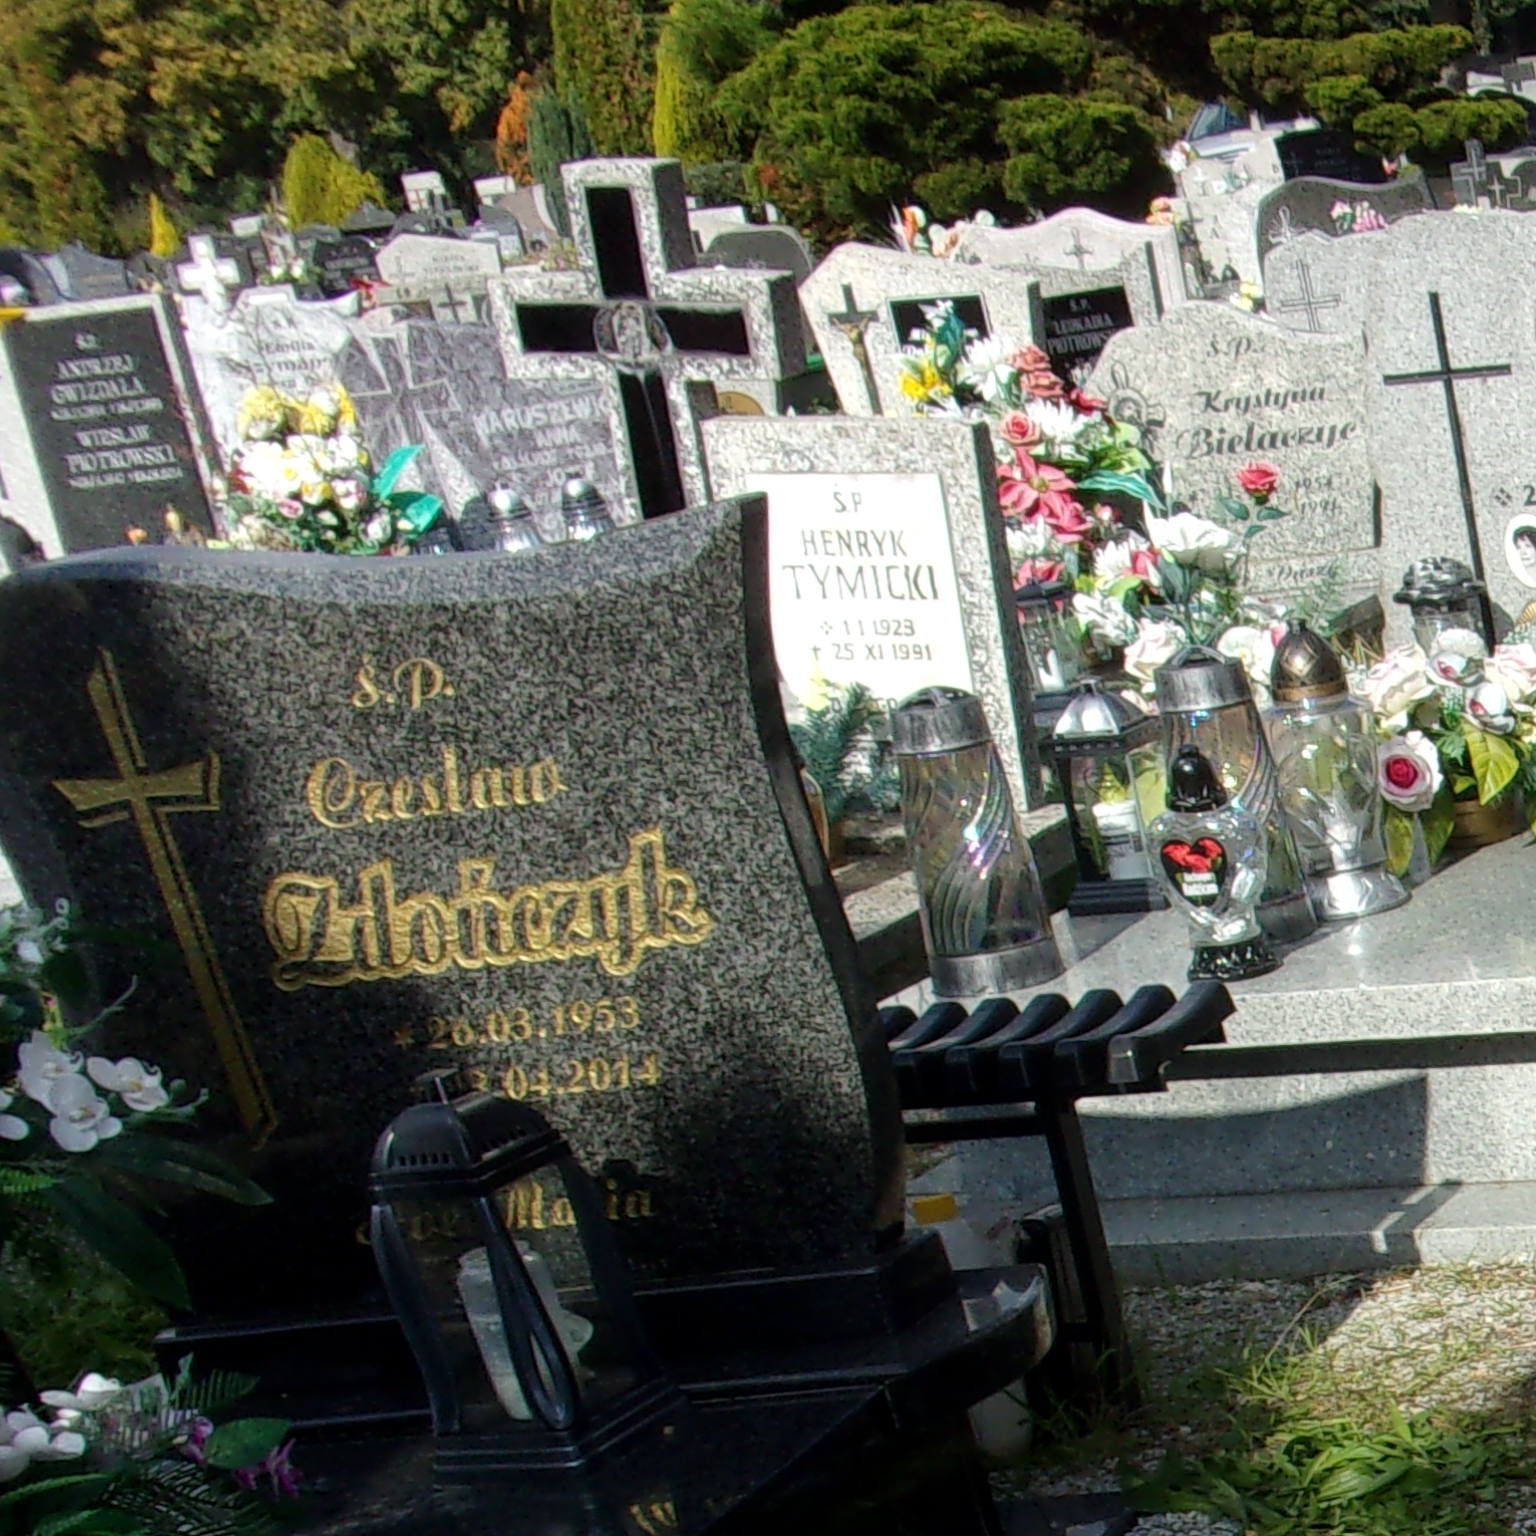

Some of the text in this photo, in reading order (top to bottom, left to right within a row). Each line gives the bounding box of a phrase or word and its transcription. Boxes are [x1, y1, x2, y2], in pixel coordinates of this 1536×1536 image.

[1197, 385, 1325, 415] Krystyna
[1177, 421, 1357, 459] Bielaczyc
[801, 529, 908, 558] HENRYK
[782, 563, 939, 601] TYMICKI
[873, 619, 916, 636] 1923
[832, 643, 932, 661] 25 XI 1991
[506, 1178, 654, 1231] Maia
